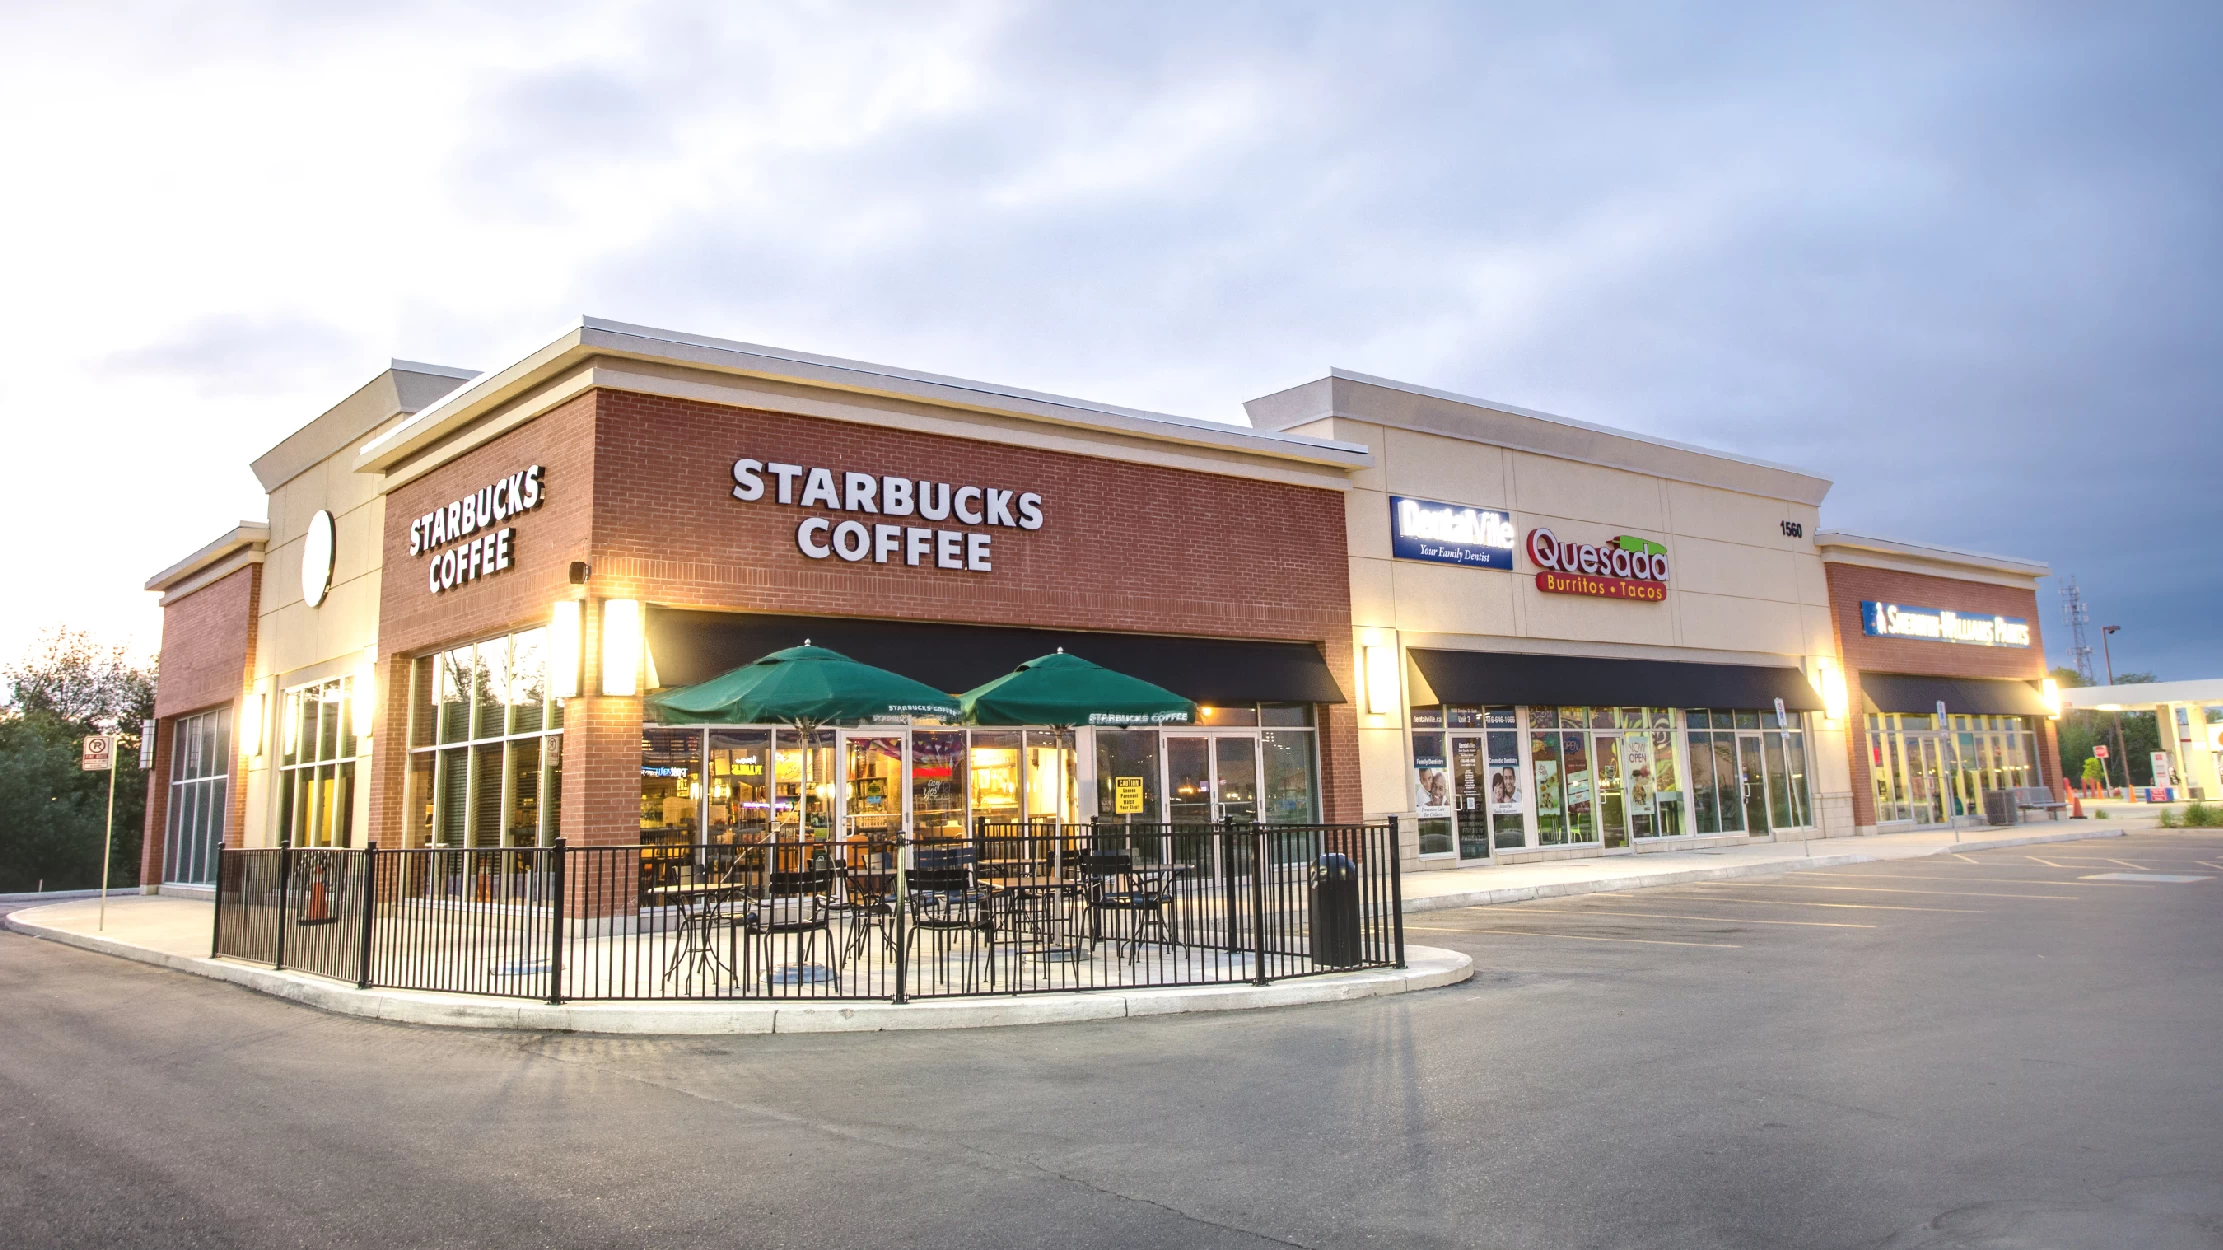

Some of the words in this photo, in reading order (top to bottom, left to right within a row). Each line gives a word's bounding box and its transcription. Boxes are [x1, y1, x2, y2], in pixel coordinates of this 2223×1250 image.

[731, 458, 1044, 530] STARBUCKS
[409, 464, 545, 557] STARBUCKS
[1780, 519, 1803, 539] 1560
[796, 517, 993, 572] COFFEE
[1420, 544, 1438, 556] Your
[1438, 547, 1463, 562] Family
[1464, 550, 1490, 562] Dentist
[1527, 528, 1670, 581] Quesada
[429, 527, 516, 594] COFFEE
[1547, 574, 1605, 595] Burritos
[1620, 581, 1663, 600] Tacos
[1088, 712, 1149, 724] STARBUCKS
[1150, 710, 1188, 722] COFFEE
[1628, 742, 1646, 753] NOW
[1628, 753, 1647, 763] OPEN
